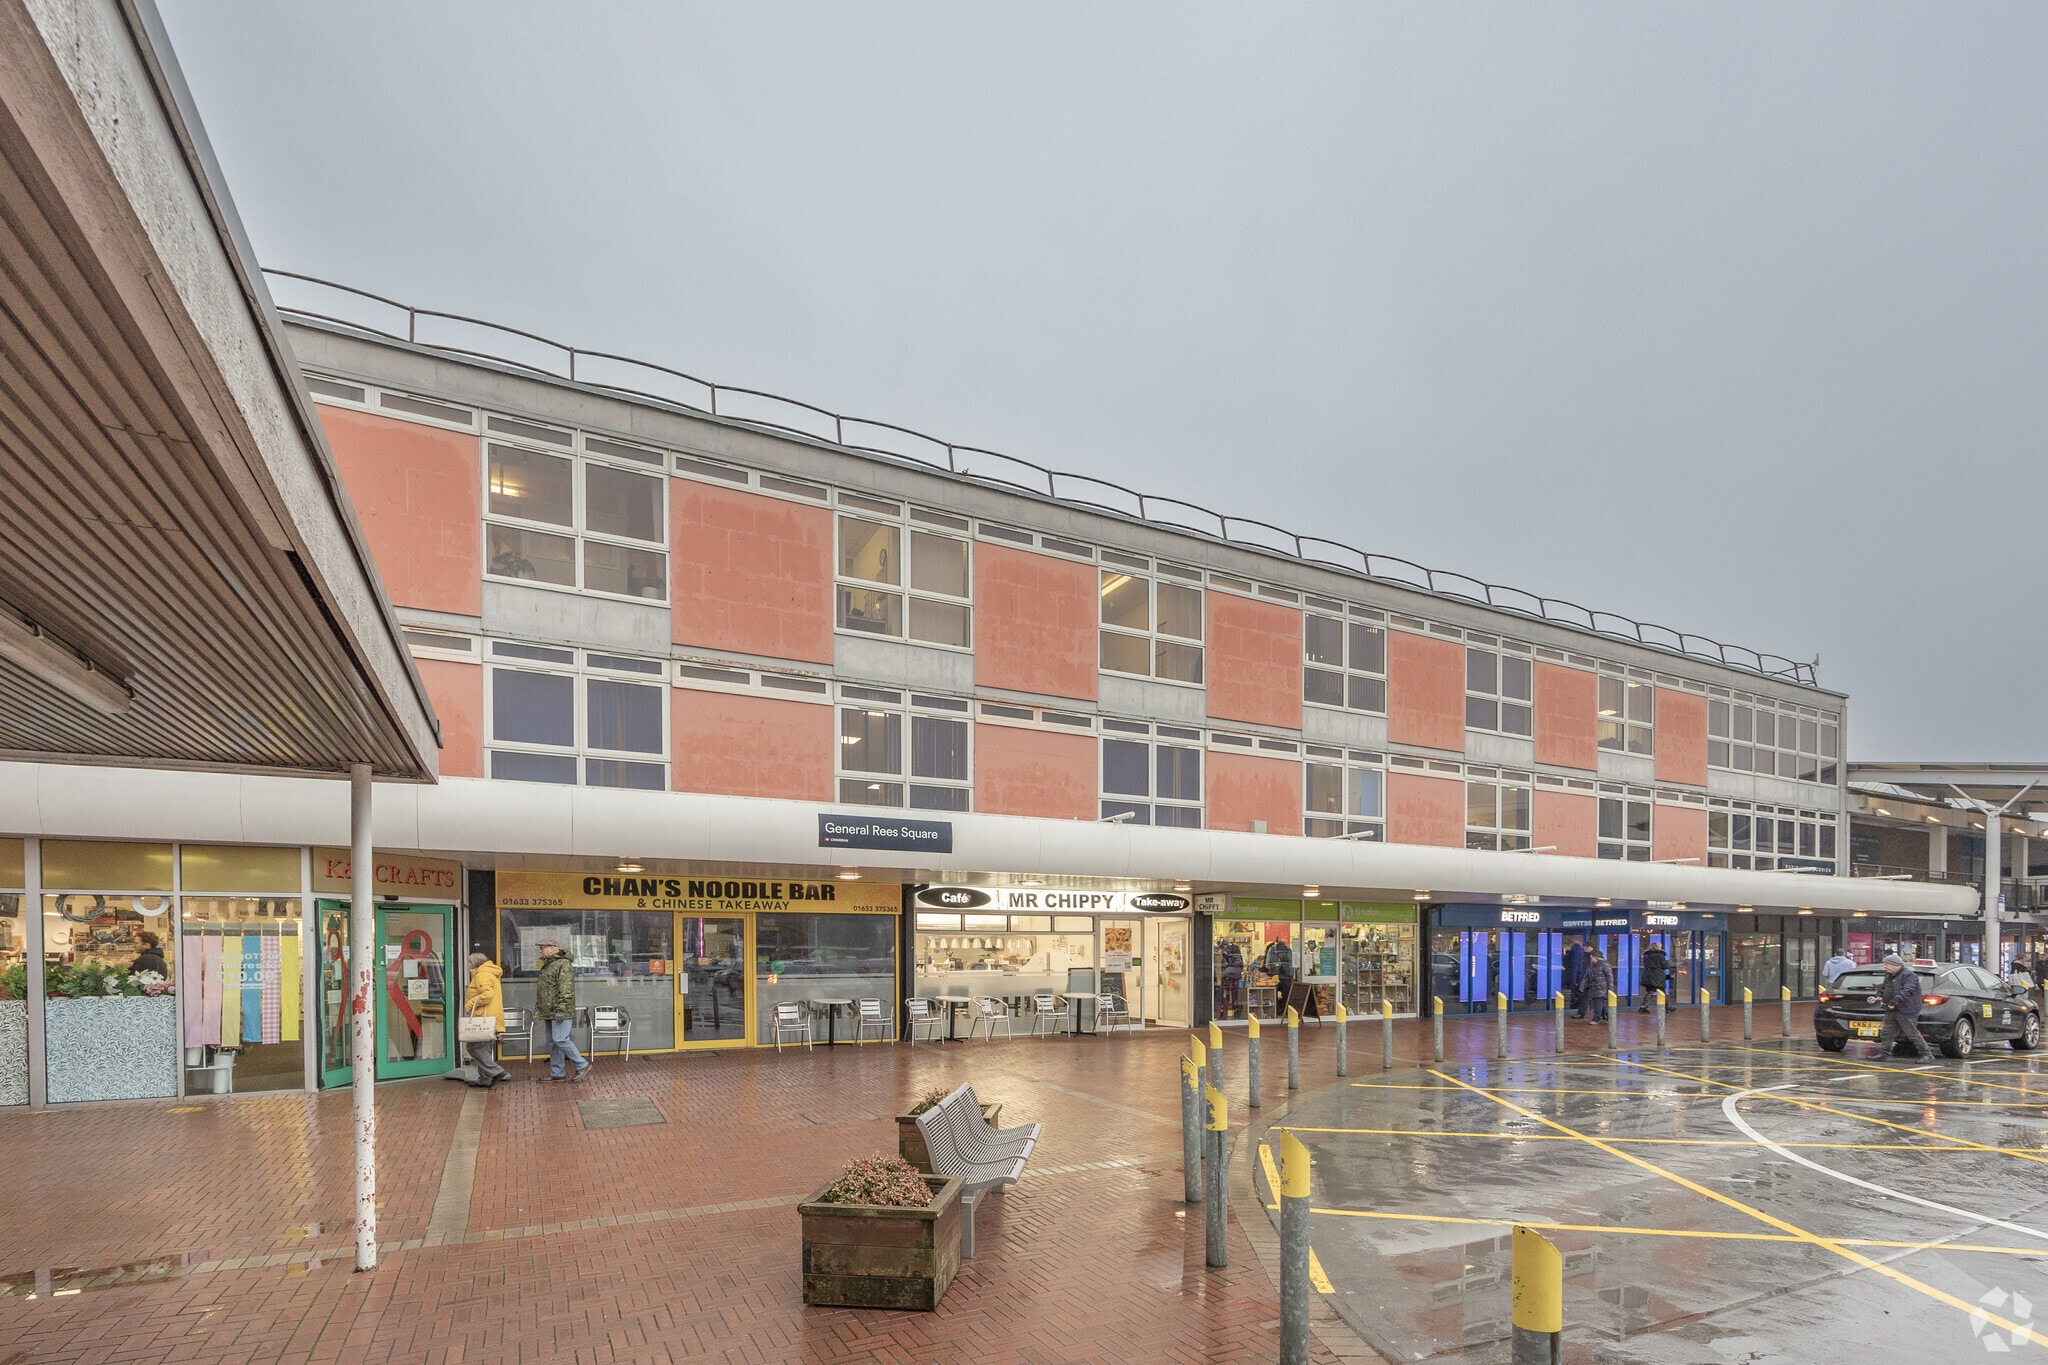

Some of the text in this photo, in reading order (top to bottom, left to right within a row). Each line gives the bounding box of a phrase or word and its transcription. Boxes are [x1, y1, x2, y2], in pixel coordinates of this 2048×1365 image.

[824, 822, 939, 841] General Rees Square
[373, 863, 455, 888] CRAFTS
[582, 876, 836, 901] CHAN'S NOODLE BAR
[502, 898, 563, 906] 01633 375365
[941, 891, 969, 904] Café
[1009, 893, 1115, 909] MR CHIPPY
[1135, 896, 1185, 909] Take-away
[637, 898, 790, 911] & CHINESE TAKEAWAY
[1501, 911, 1540, 922] BETFRED
[1646, 915, 1678, 925] BETFRED
